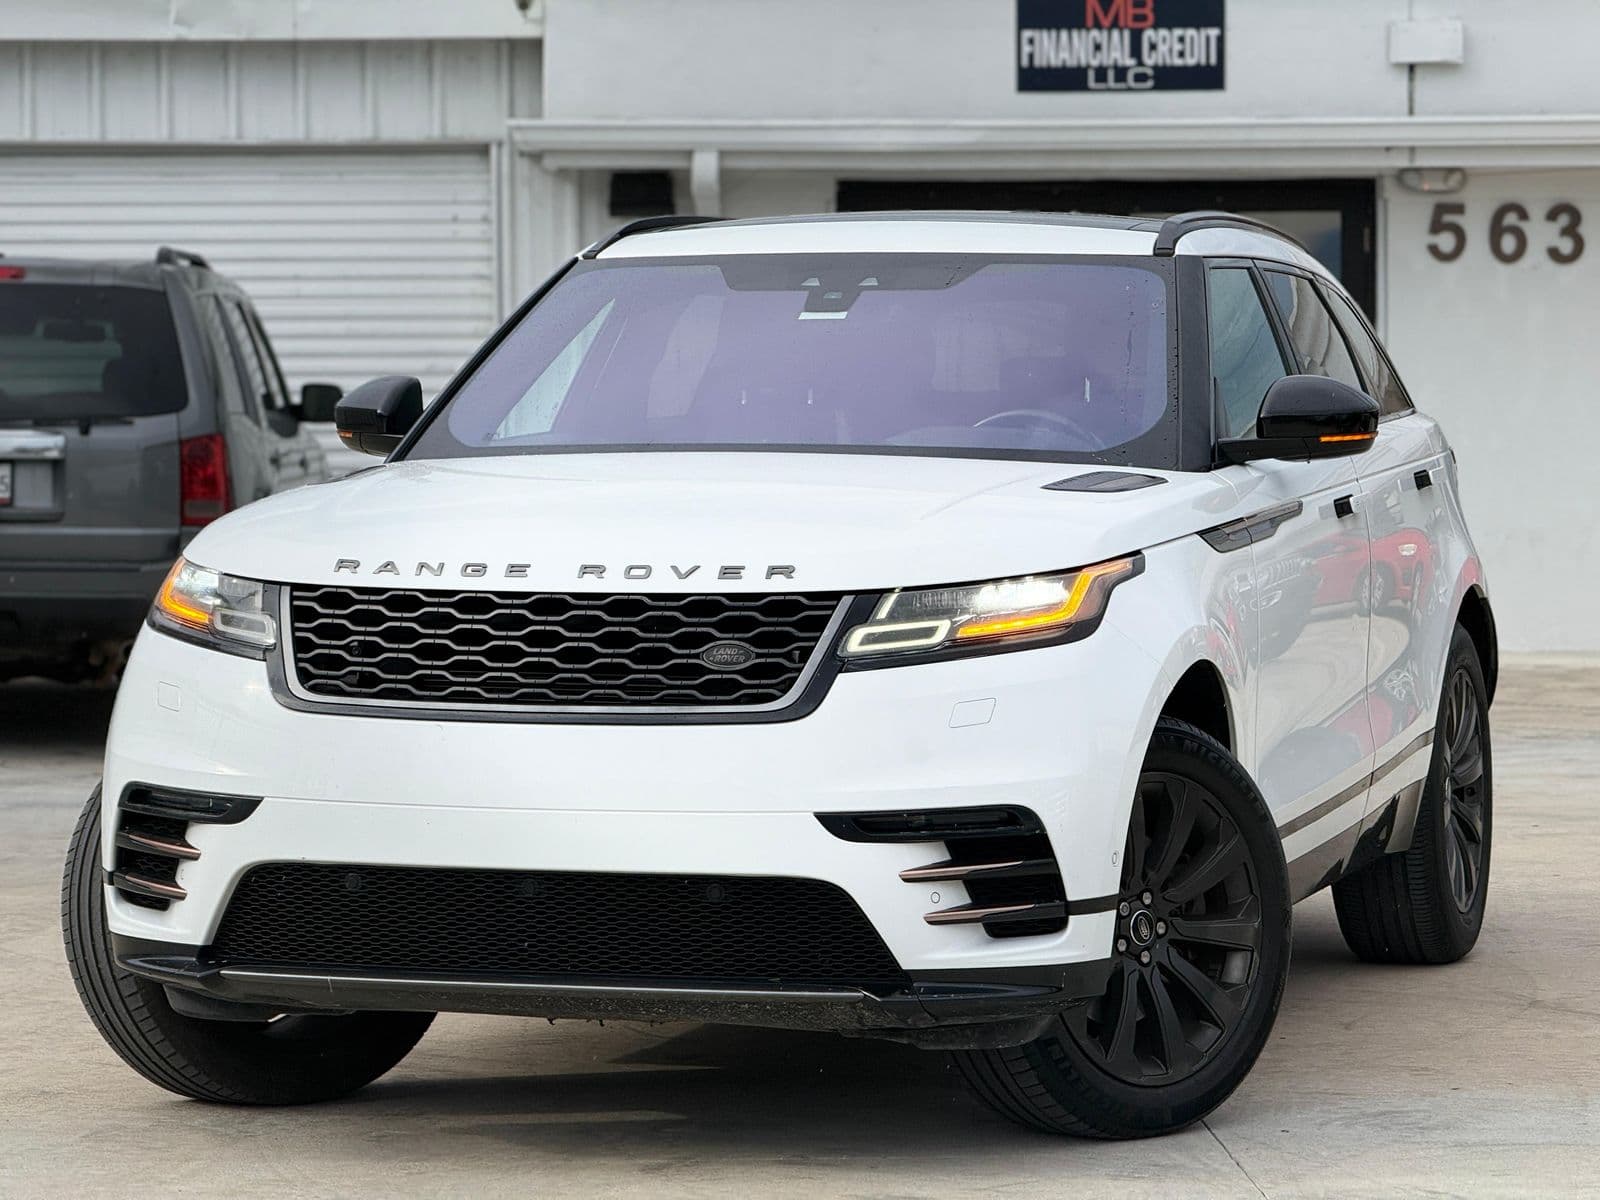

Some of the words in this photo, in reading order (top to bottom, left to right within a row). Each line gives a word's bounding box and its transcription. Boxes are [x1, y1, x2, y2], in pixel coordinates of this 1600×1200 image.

[1085, 0, 1156, 28] MB
[1020, 28, 1137, 68] FINANCIAL
[1141, 27, 1221, 67] CREDIT
[1087, 67, 1155, 89] LLC
[1427, 202, 1585, 264] 563
[334, 558, 531, 578] RANGE
[577, 564, 796, 580] ROVER
